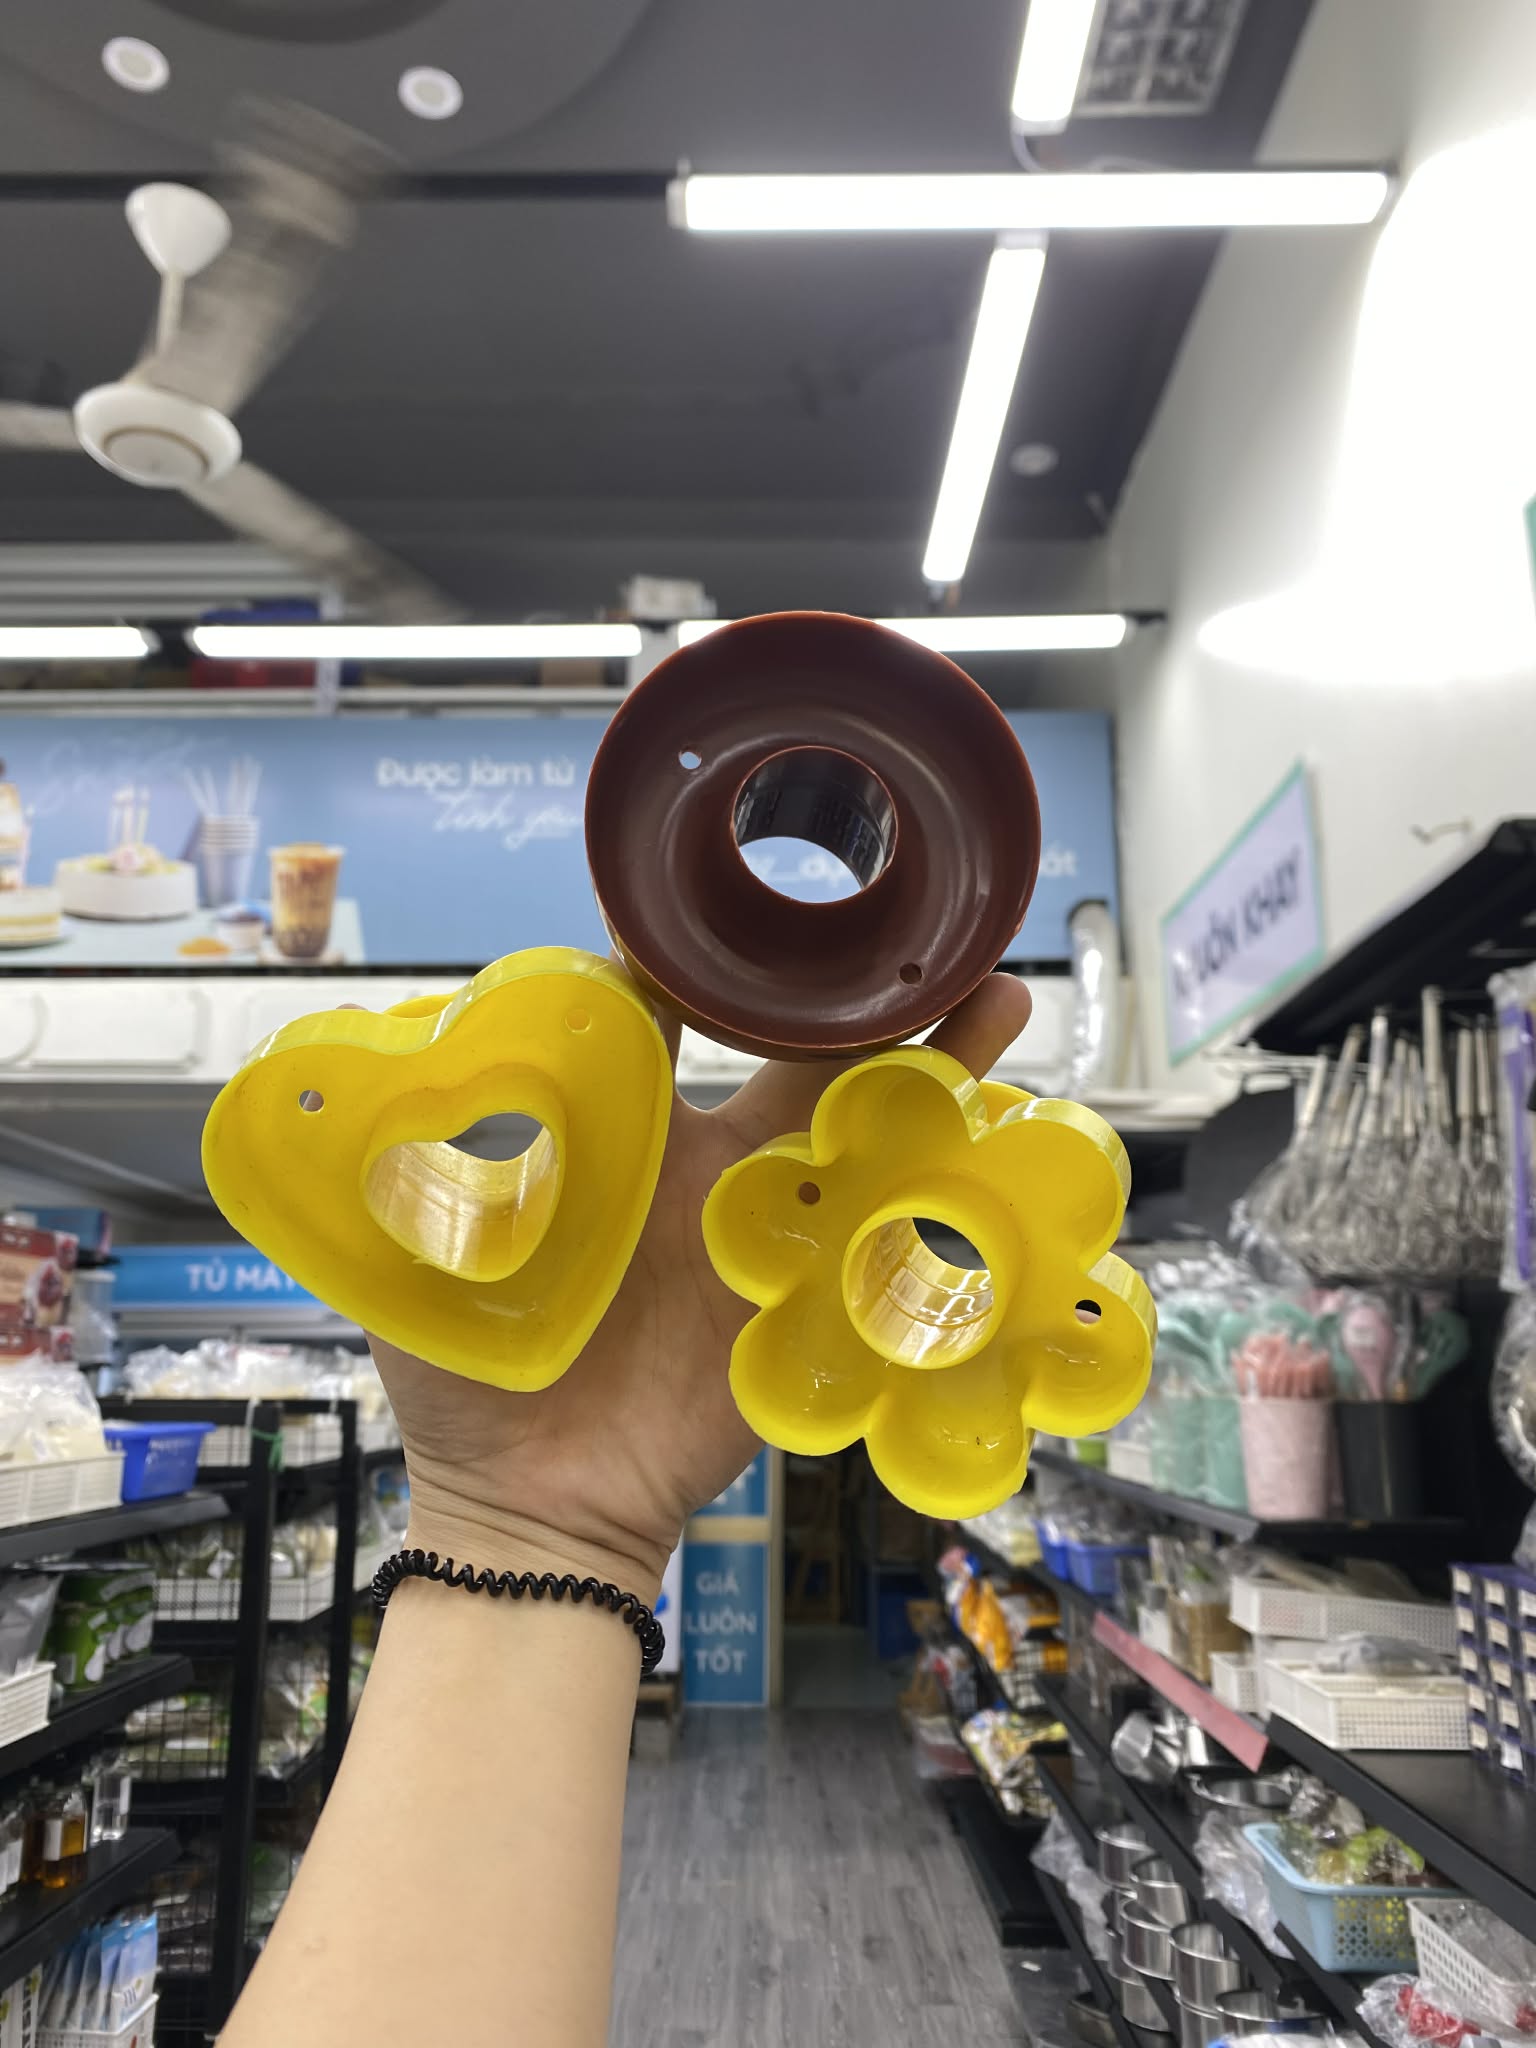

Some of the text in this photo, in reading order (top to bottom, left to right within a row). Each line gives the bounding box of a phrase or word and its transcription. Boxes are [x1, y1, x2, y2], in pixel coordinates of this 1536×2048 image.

[696, 1565, 740, 1596] GIÁ
[684, 1604, 758, 1635] LUÔN
[694, 1642, 748, 1675] TỐT
